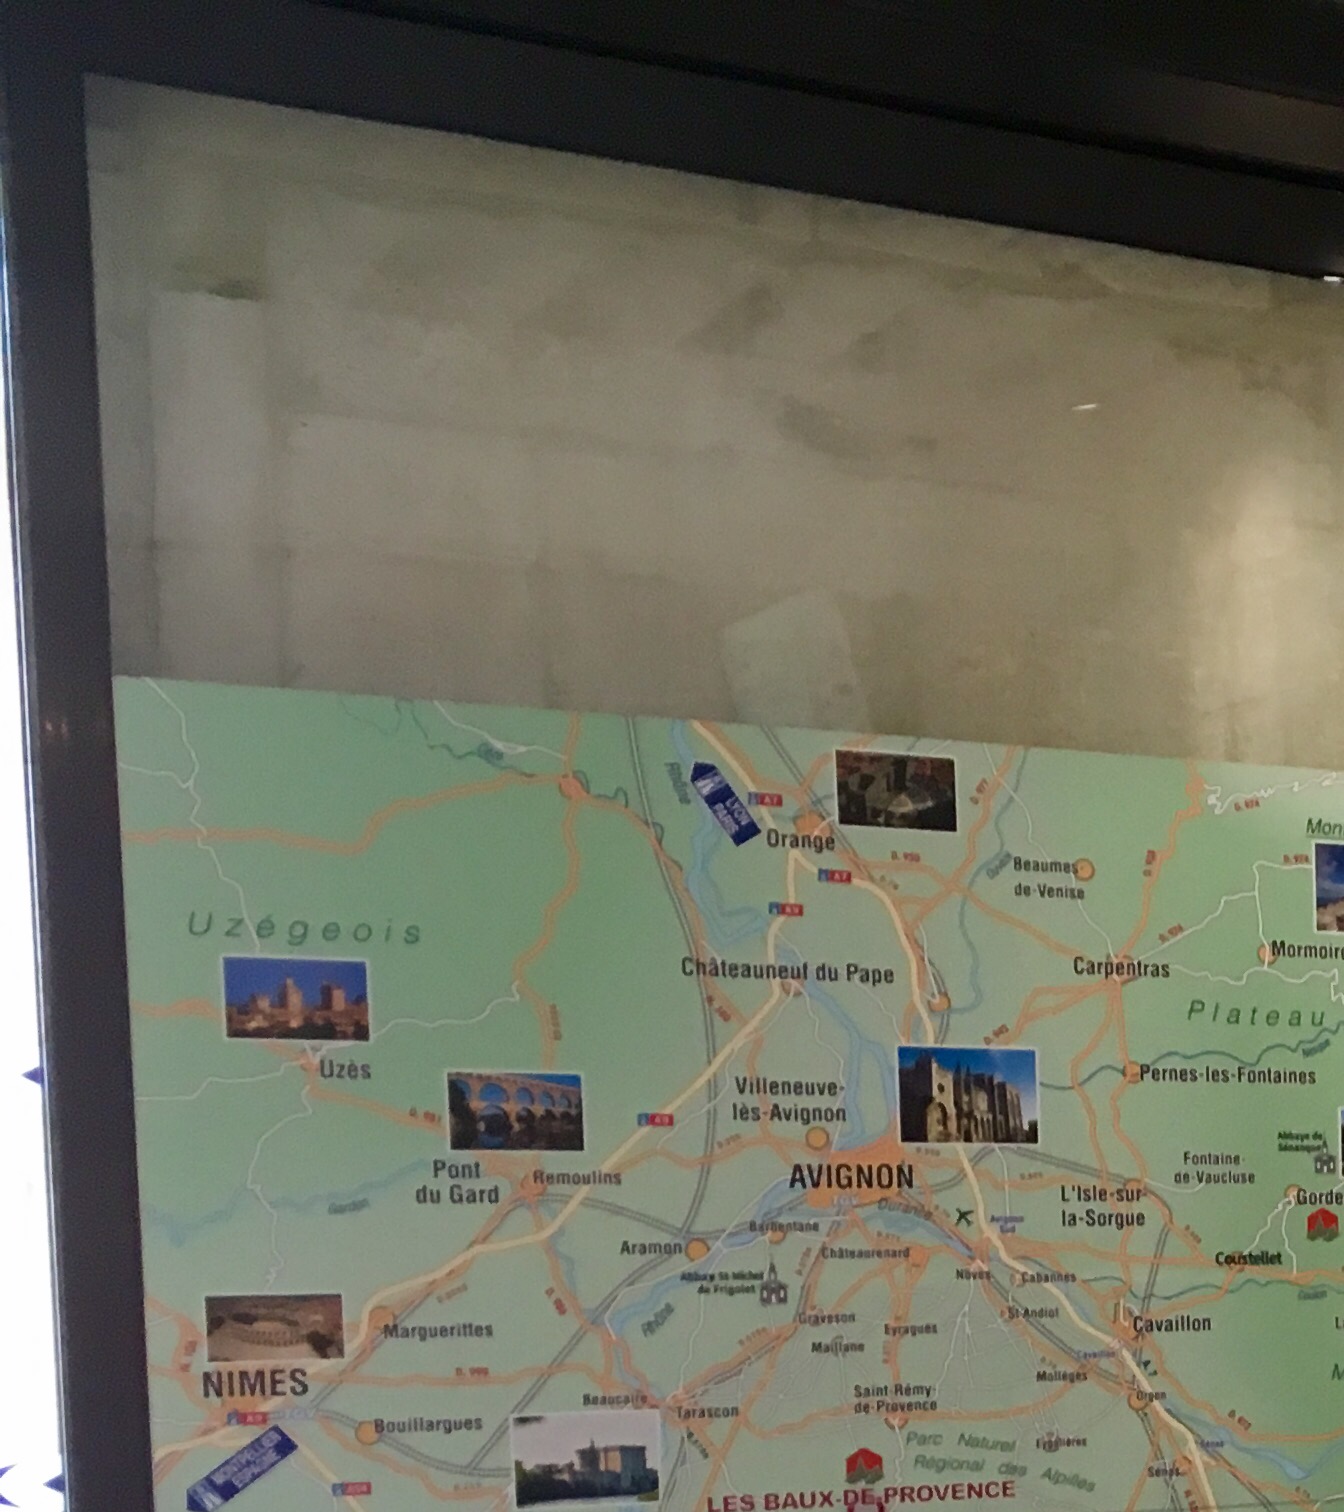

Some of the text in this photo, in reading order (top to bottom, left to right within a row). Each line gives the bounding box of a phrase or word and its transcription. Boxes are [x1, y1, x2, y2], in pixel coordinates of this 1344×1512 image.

[766, 828, 836, 854] Orange
[1013, 855, 1079, 876] Beaumes
[1013, 881, 1086, 902] de-Venise
[188, 910, 421, 947] Uzégeois
[681, 955, 895, 988] Châteauneuf du Pape
[1073, 957, 1171, 982] Carpentras
[1187, 1000, 1326, 1028] Plateau
[319, 1058, 372, 1081] Uzès
[1139, 1062, 1317, 1086] Pernes-les-Fontaines
[734, 1076, 845, 1099] Villeneuve-
[731, 1102, 847, 1124] lès-Avignon
[431, 1158, 482, 1181] Pont
[531, 1168, 623, 1187] Remoulins
[788, 1163, 915, 1190] AVIGNON
[1173, 1168, 1256, 1186] de-Vaucluse
[415, 1183, 500, 1206] du Gard
[1060, 1183, 1147, 1205] L'Isle-sur-
[1061, 1208, 1146, 1229] la-Sorgue
[619, 1239, 684, 1257] Aramon
[1214, 1250, 1283, 1267] Coustellet
[798, 1310, 856, 1325] Graveson
[1132, 1315, 1213, 1335] Cavaillon
[382, 1321, 494, 1340] Marguerittes
[202, 1366, 309, 1399] NIMES
[676, 1404, 740, 1420] Tarascon
[373, 1415, 484, 1437] Bouillargues
[905, 1430, 944, 1449] Parc
[763, 1479, 1017, 1512] BAUX-DE-PROVENCE
